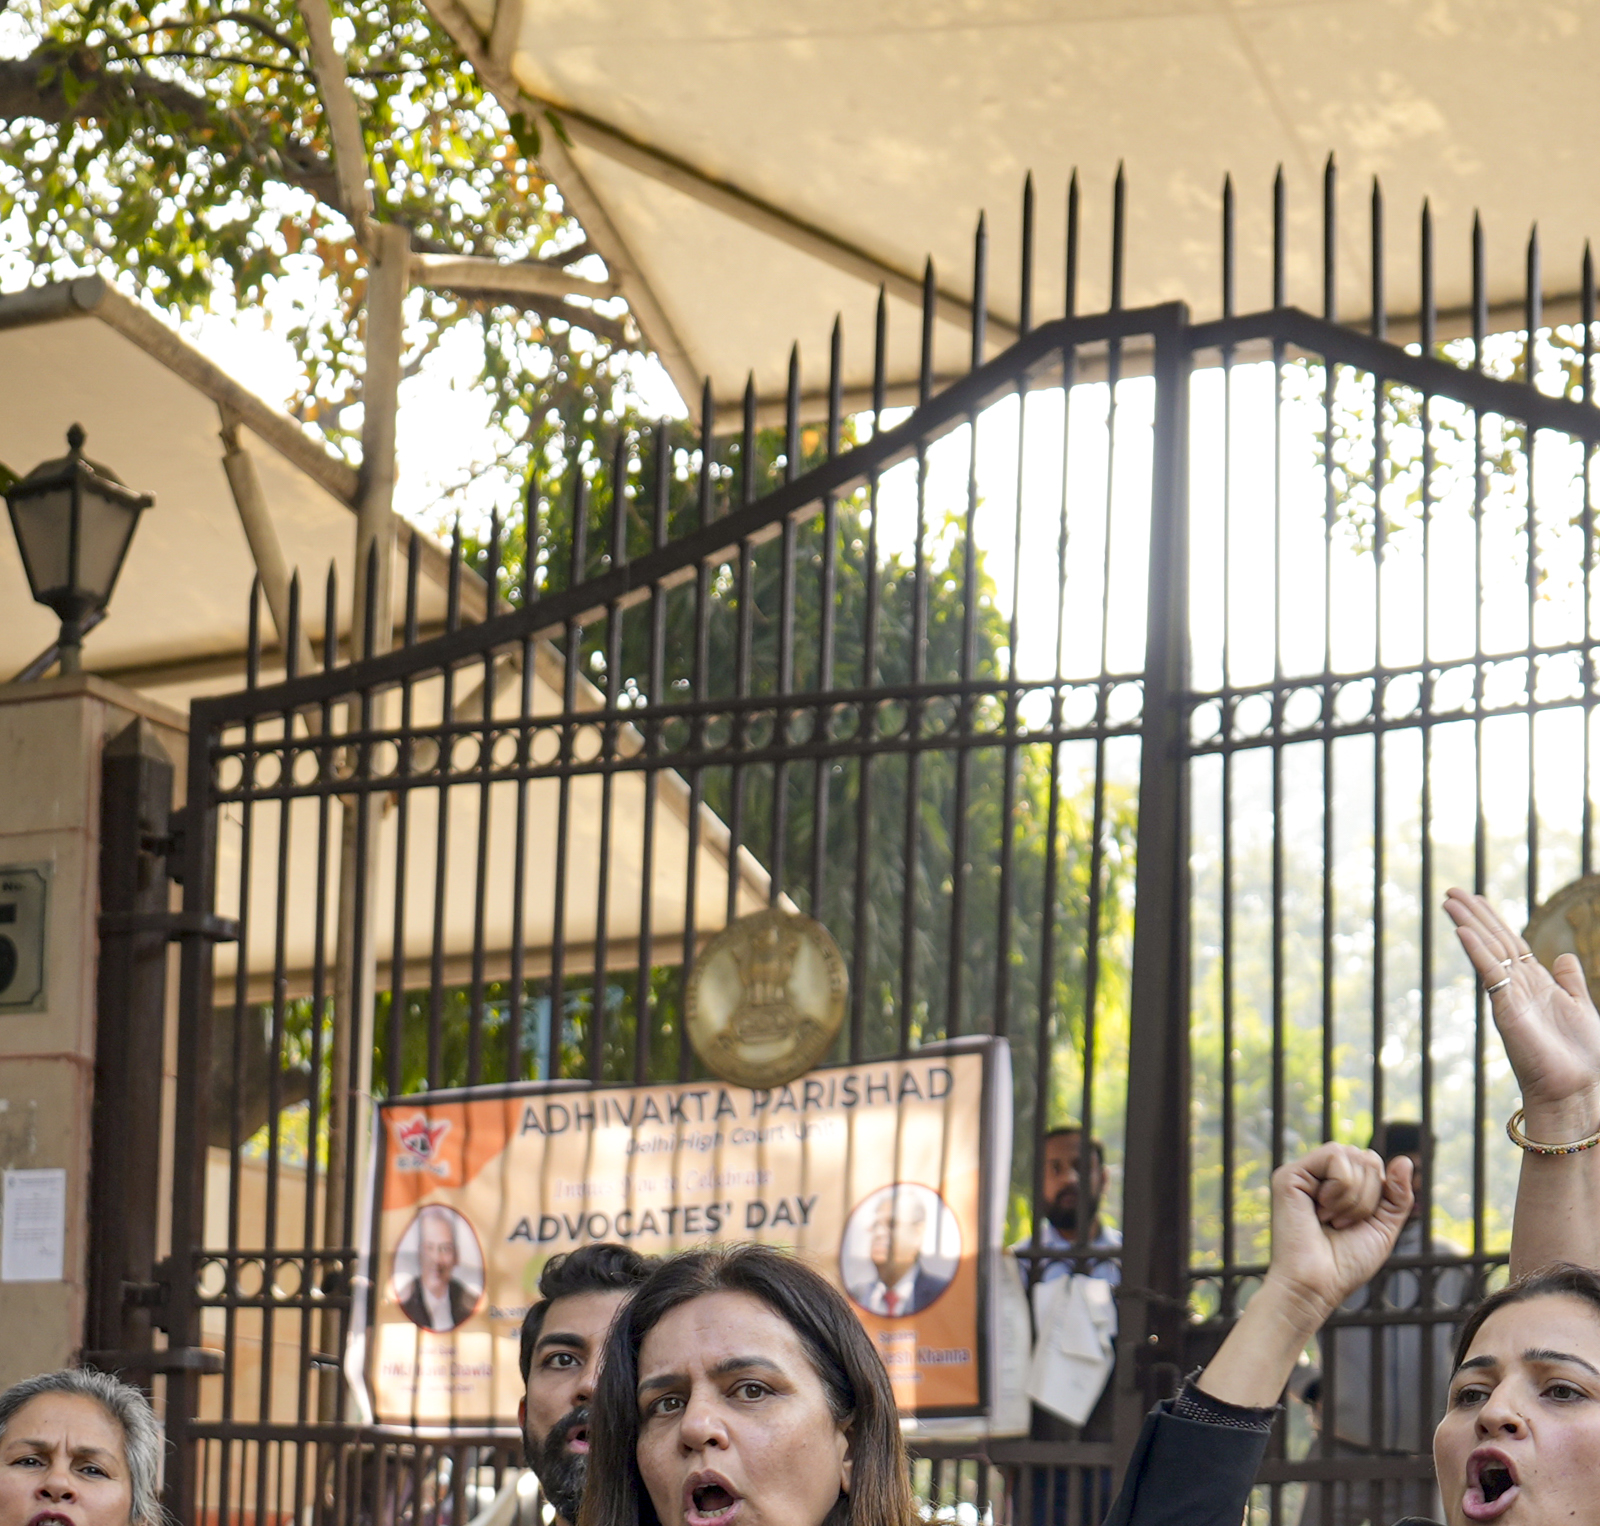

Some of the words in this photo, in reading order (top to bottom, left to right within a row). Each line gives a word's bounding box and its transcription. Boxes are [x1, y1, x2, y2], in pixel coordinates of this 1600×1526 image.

[519, 1088, 738, 1138] ADHIVAKTA
[750, 1066, 955, 1118] PARISHAD
[626, 1133, 677, 1156] Delhi
[681, 1130, 725, 1152] High
[732, 1124, 786, 1146] Court
[745, 1195, 820, 1231] DAY
